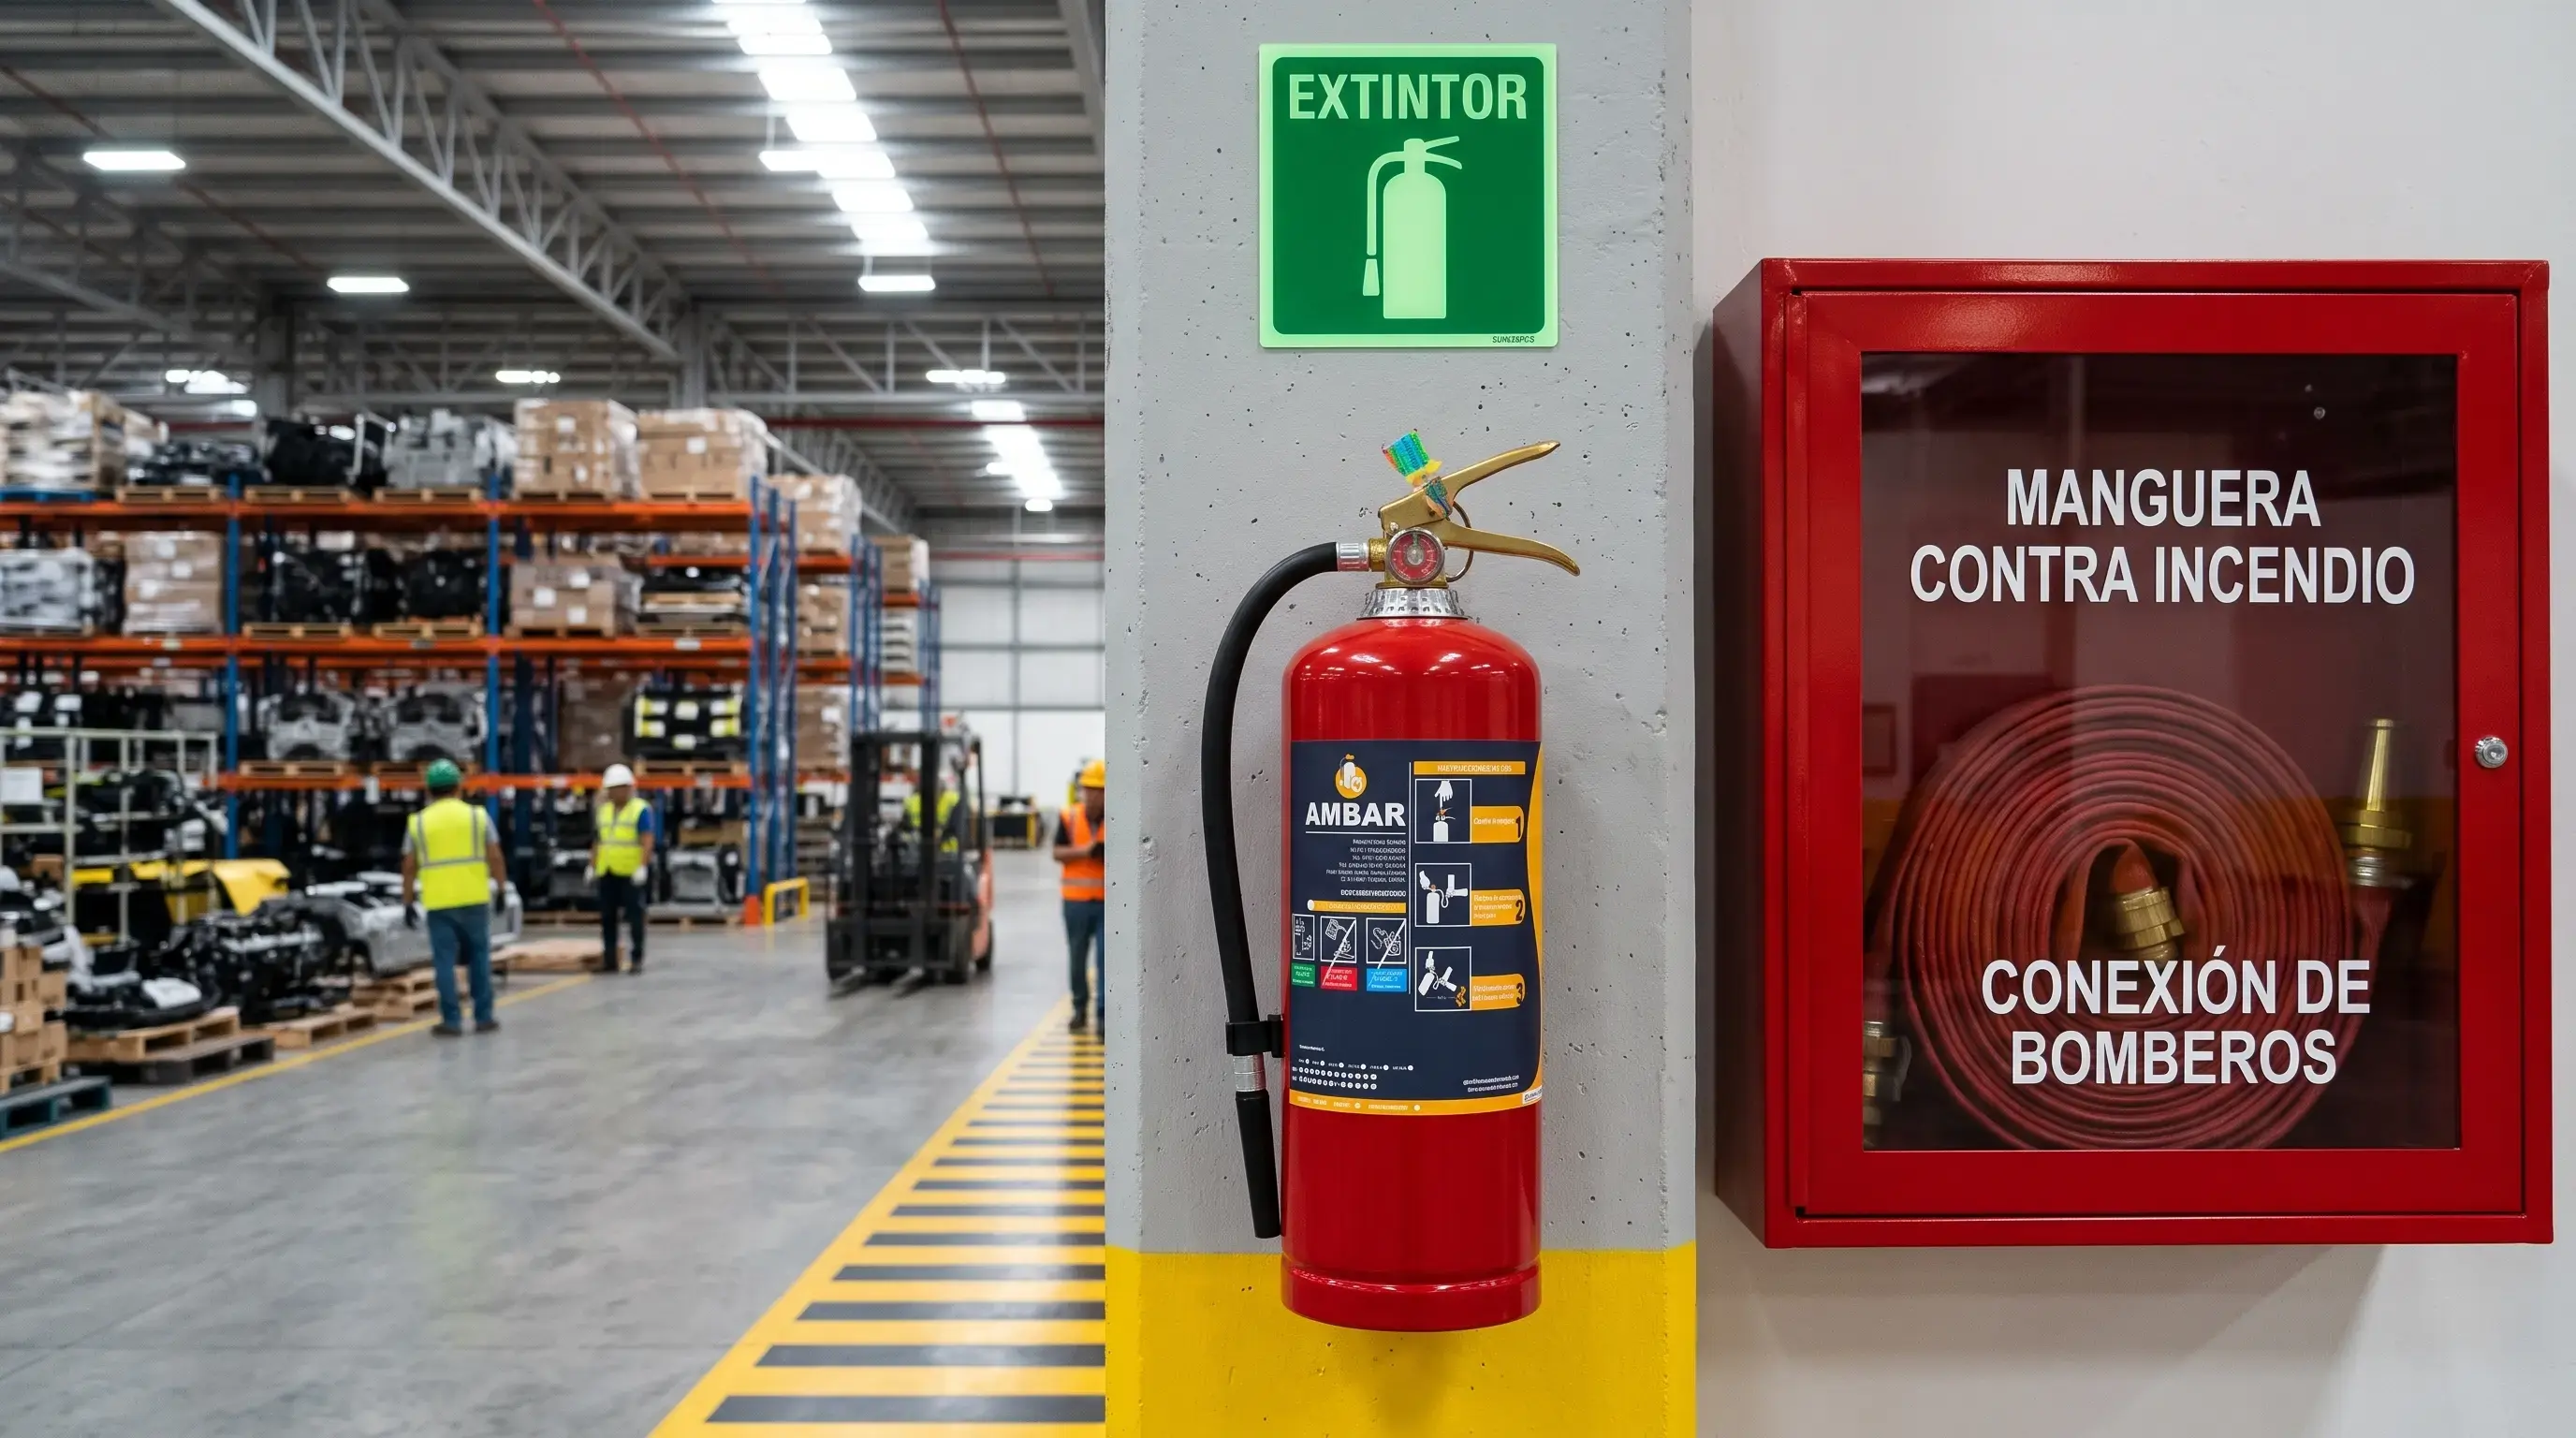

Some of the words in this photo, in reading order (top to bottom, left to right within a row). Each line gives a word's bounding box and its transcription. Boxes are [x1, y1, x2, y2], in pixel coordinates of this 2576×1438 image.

[1289, 73, 1527, 120] EXTINTOR
[2007, 468, 2321, 527] MANGUERA
[1910, 544, 2139, 604] CONTRA
[2155, 545, 2415, 605] INCENDIO
[1305, 801, 1407, 827] AMBAR
[1515, 899, 1523, 921] 2
[1982, 946, 2276, 1015] CONEXIÓN
[2297, 960, 2370, 1014] DE
[2012, 1029, 2336, 1085] BOMBEROS
